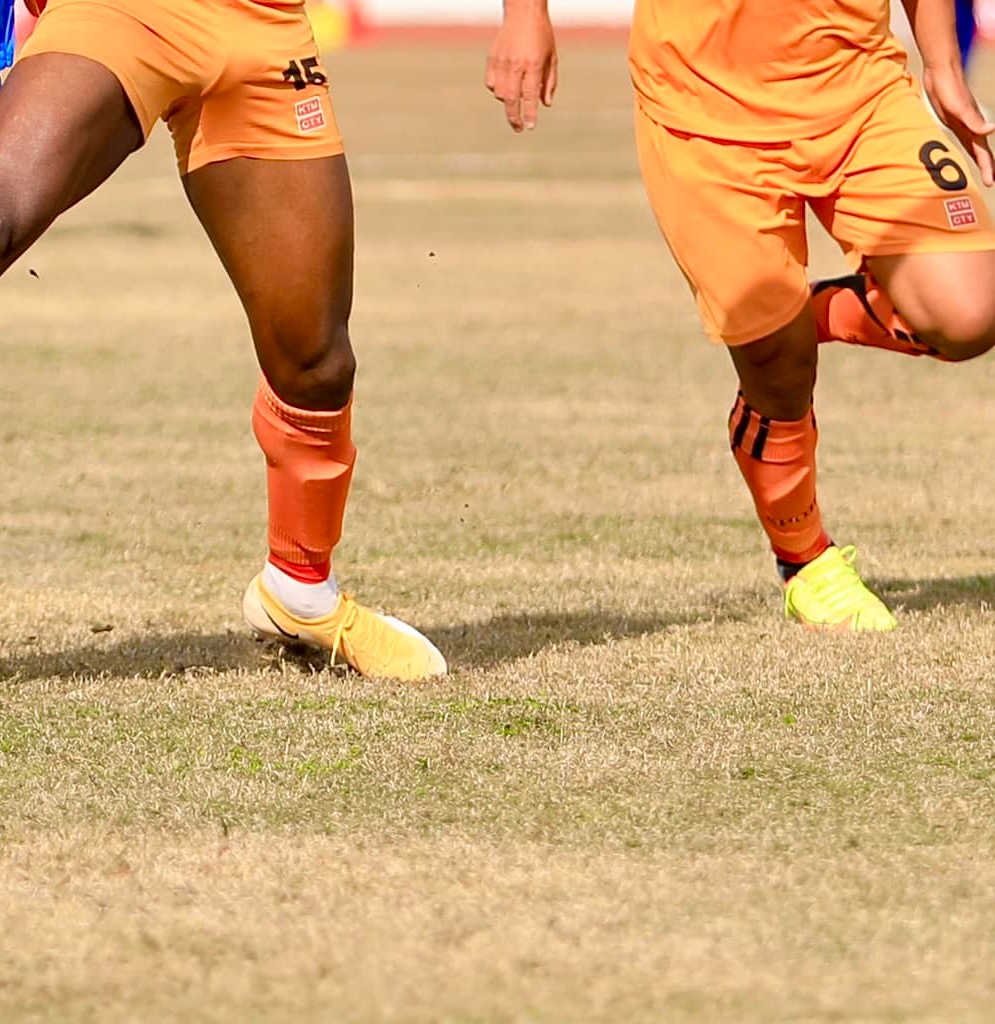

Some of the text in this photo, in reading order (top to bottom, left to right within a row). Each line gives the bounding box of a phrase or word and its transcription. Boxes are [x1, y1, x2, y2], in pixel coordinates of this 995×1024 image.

[282, 56, 328, 91] 15
[297, 98, 320, 115] KTM
[300, 114, 324, 130] CTY
[918, 139, 968, 191] 6
[946, 198, 971, 213] KTM
[951, 213, 974, 226] CTY
